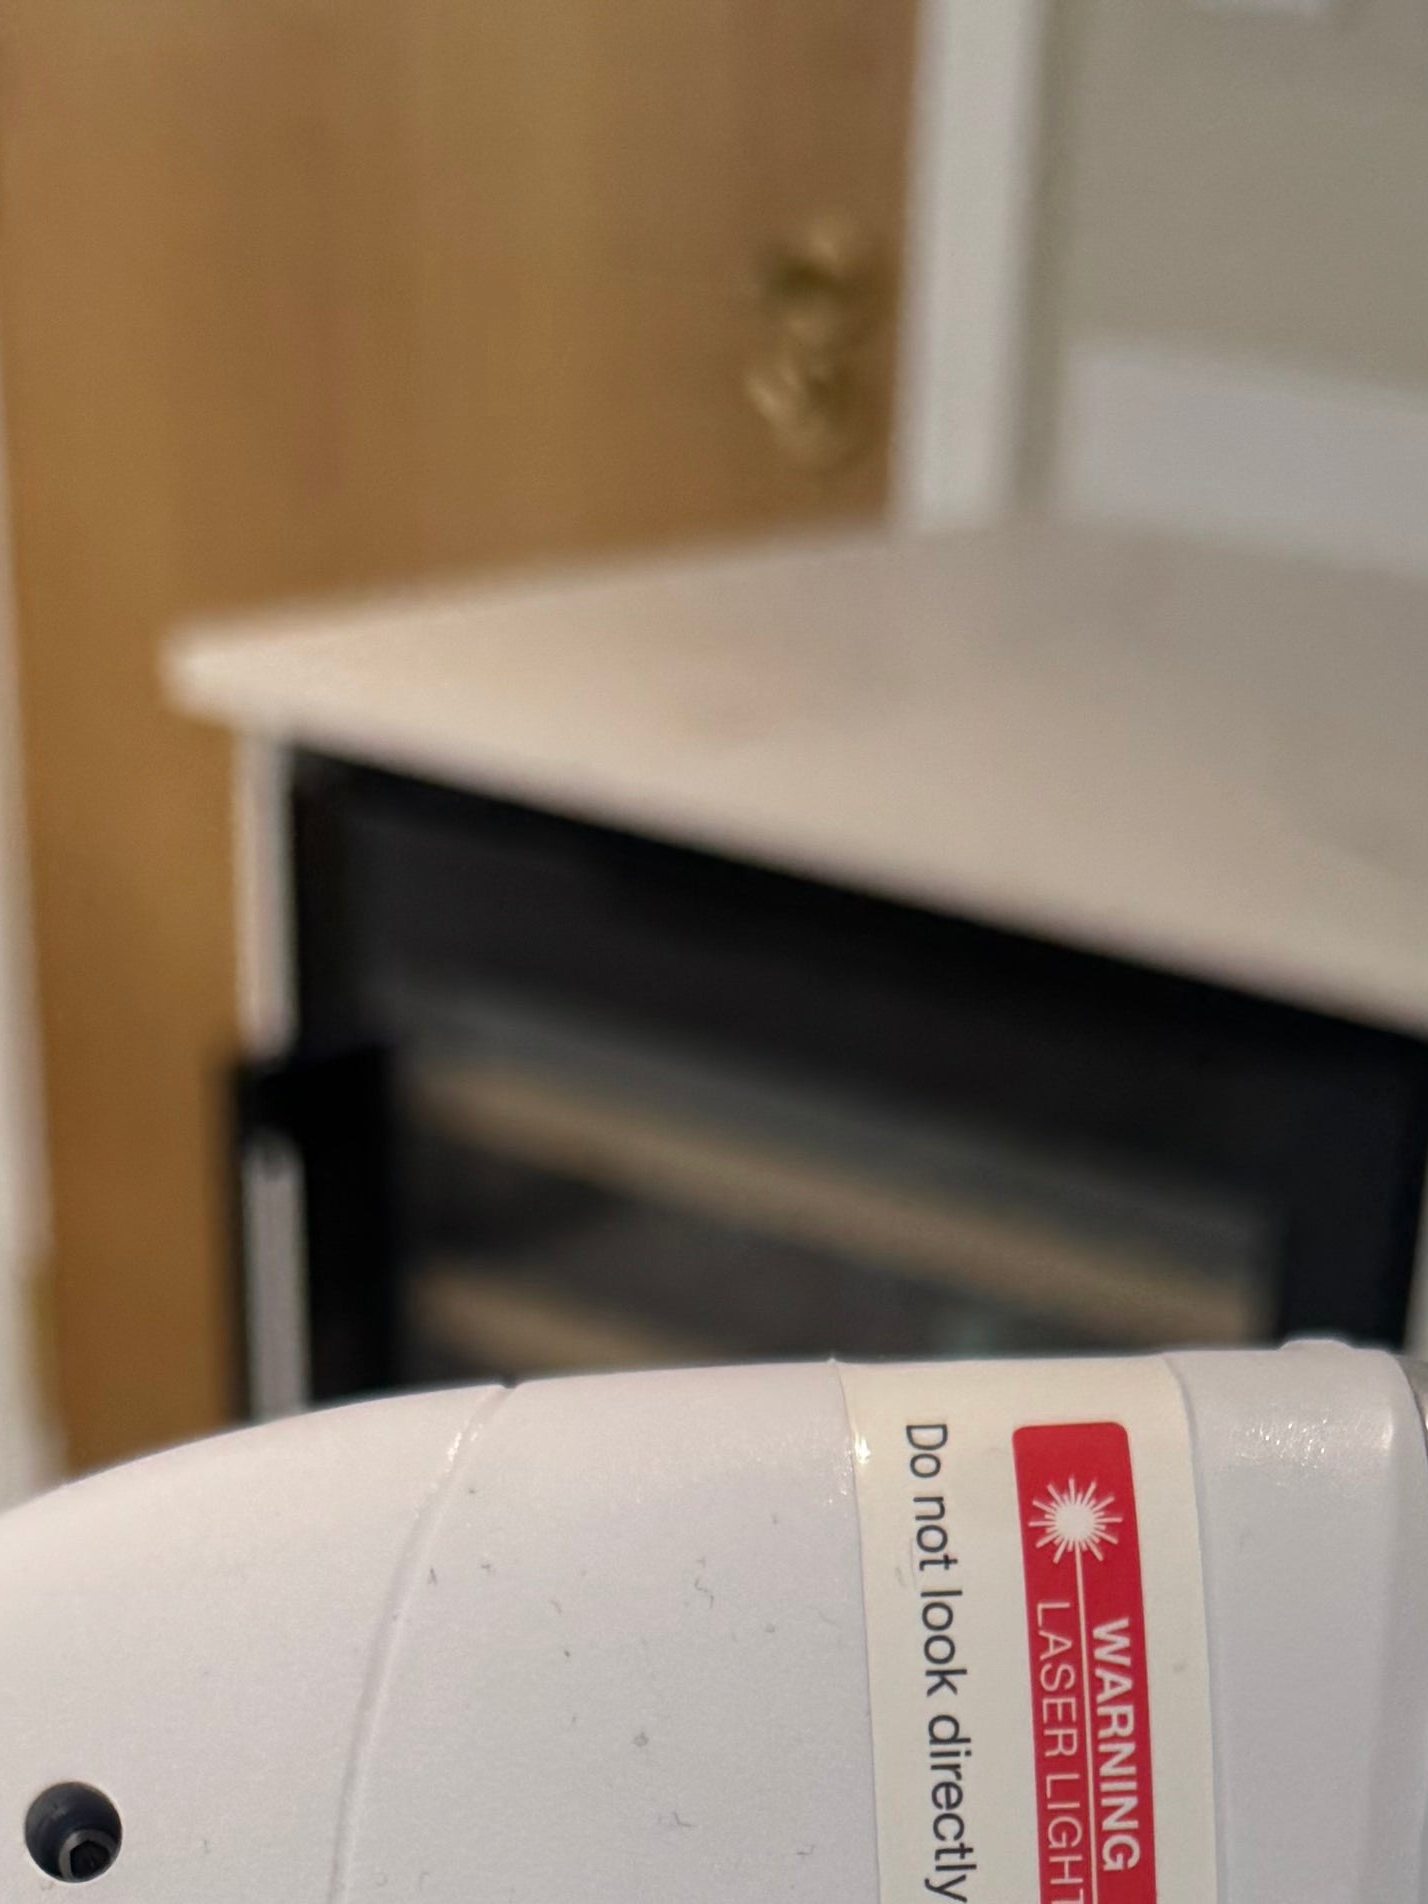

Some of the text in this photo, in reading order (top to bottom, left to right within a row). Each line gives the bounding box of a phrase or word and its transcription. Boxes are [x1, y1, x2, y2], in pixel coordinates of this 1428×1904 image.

[906, 1422, 948, 1479] Do
[913, 1496, 958, 1571] not
[920, 1589, 968, 1697] look
[1037, 1601, 1078, 1757] LASER
[924, 1714, 978, 1904] directly
[1092, 1617, 1140, 1871] WARNING
